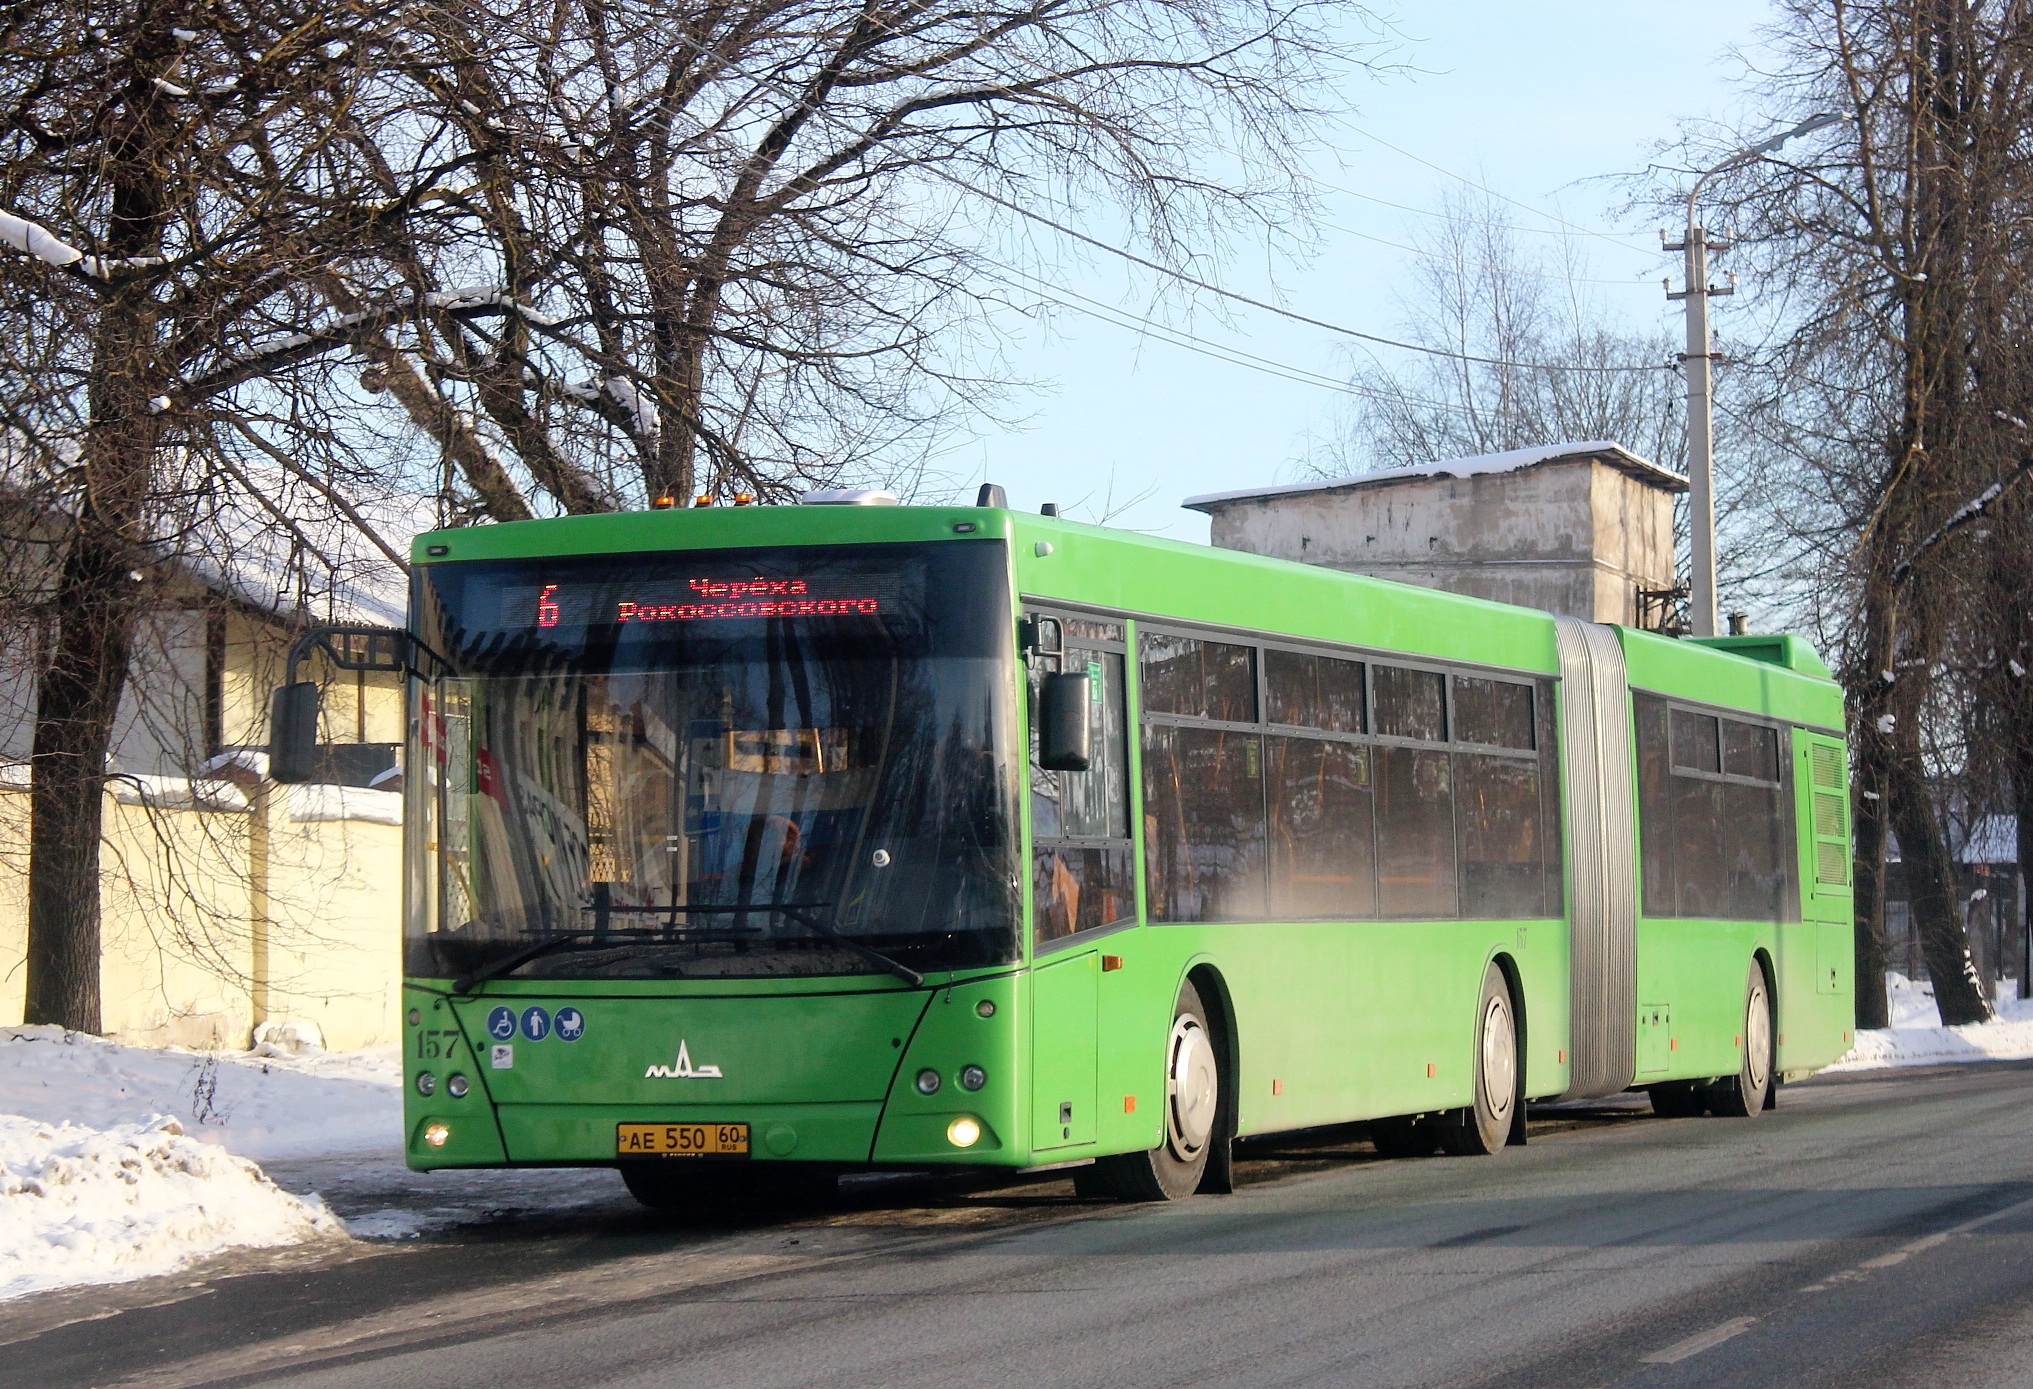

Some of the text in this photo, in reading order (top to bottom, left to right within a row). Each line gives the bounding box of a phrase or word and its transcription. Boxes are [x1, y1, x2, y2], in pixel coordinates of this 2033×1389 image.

[689, 577, 808, 599] Черёха
[539, 584, 558, 627] 6
[618, 598, 878, 621] Рокоссовского
[416, 1030, 461, 1059] 157
[666, 1127, 705, 1149] 550
[719, 1126, 740, 1143] 60
